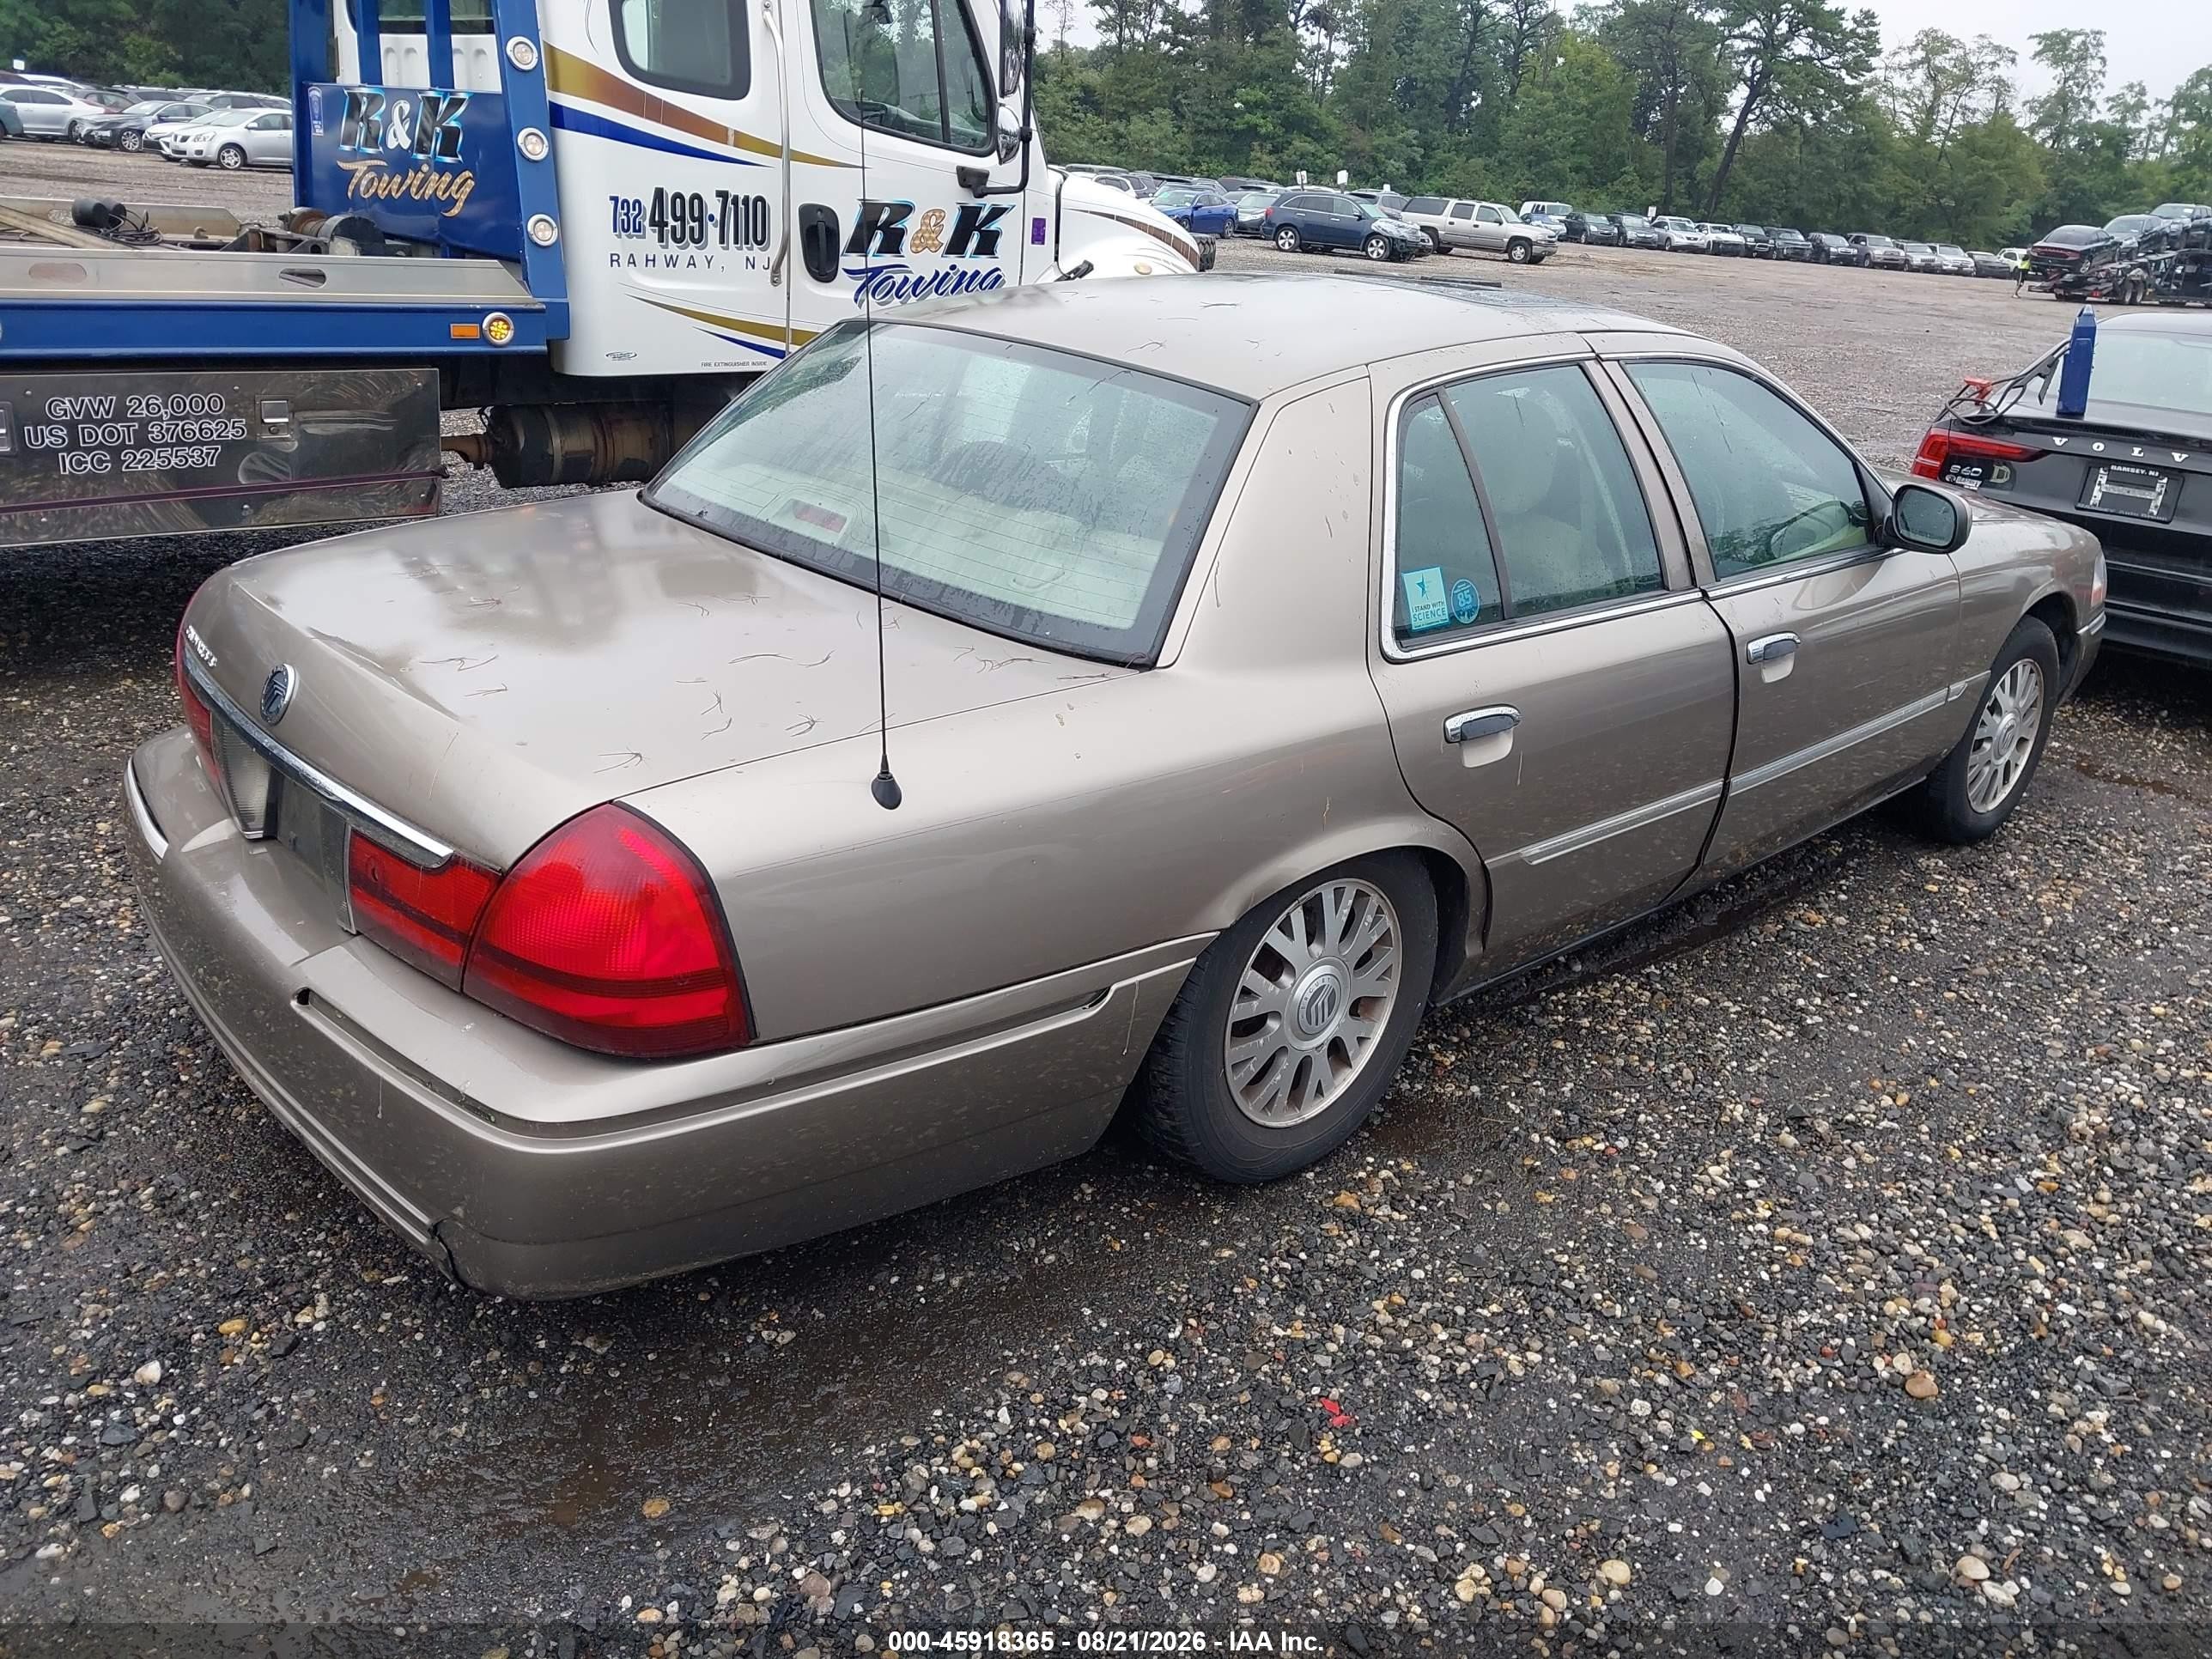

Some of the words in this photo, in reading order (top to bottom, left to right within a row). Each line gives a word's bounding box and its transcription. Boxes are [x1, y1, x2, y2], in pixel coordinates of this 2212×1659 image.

[338, 87, 473, 163] R&K
[336, 160, 475, 217] Towing
[609, 195, 644, 236] 732
[841, 198, 1017, 259] R&K
[610, 252, 726, 272] RAHWAY,
[745, 256, 771, 270] NJ
[46, 397, 116, 421] GVW
[126, 393, 225, 421] 26,000
[24, 426, 68, 448] US
[78, 423, 138, 447] DOT
[149, 419, 247, 444] 376625
[58, 451, 111, 475] ICC
[121, 446, 221, 471] 225537
[1949, 465, 1983, 477] S60
[1414, 603, 1431, 612] STAND
[1431, 600, 1445, 609] WITH
[1457, 589, 1472, 607] 85
[1413, 607, 1447, 623] SCIENCE
